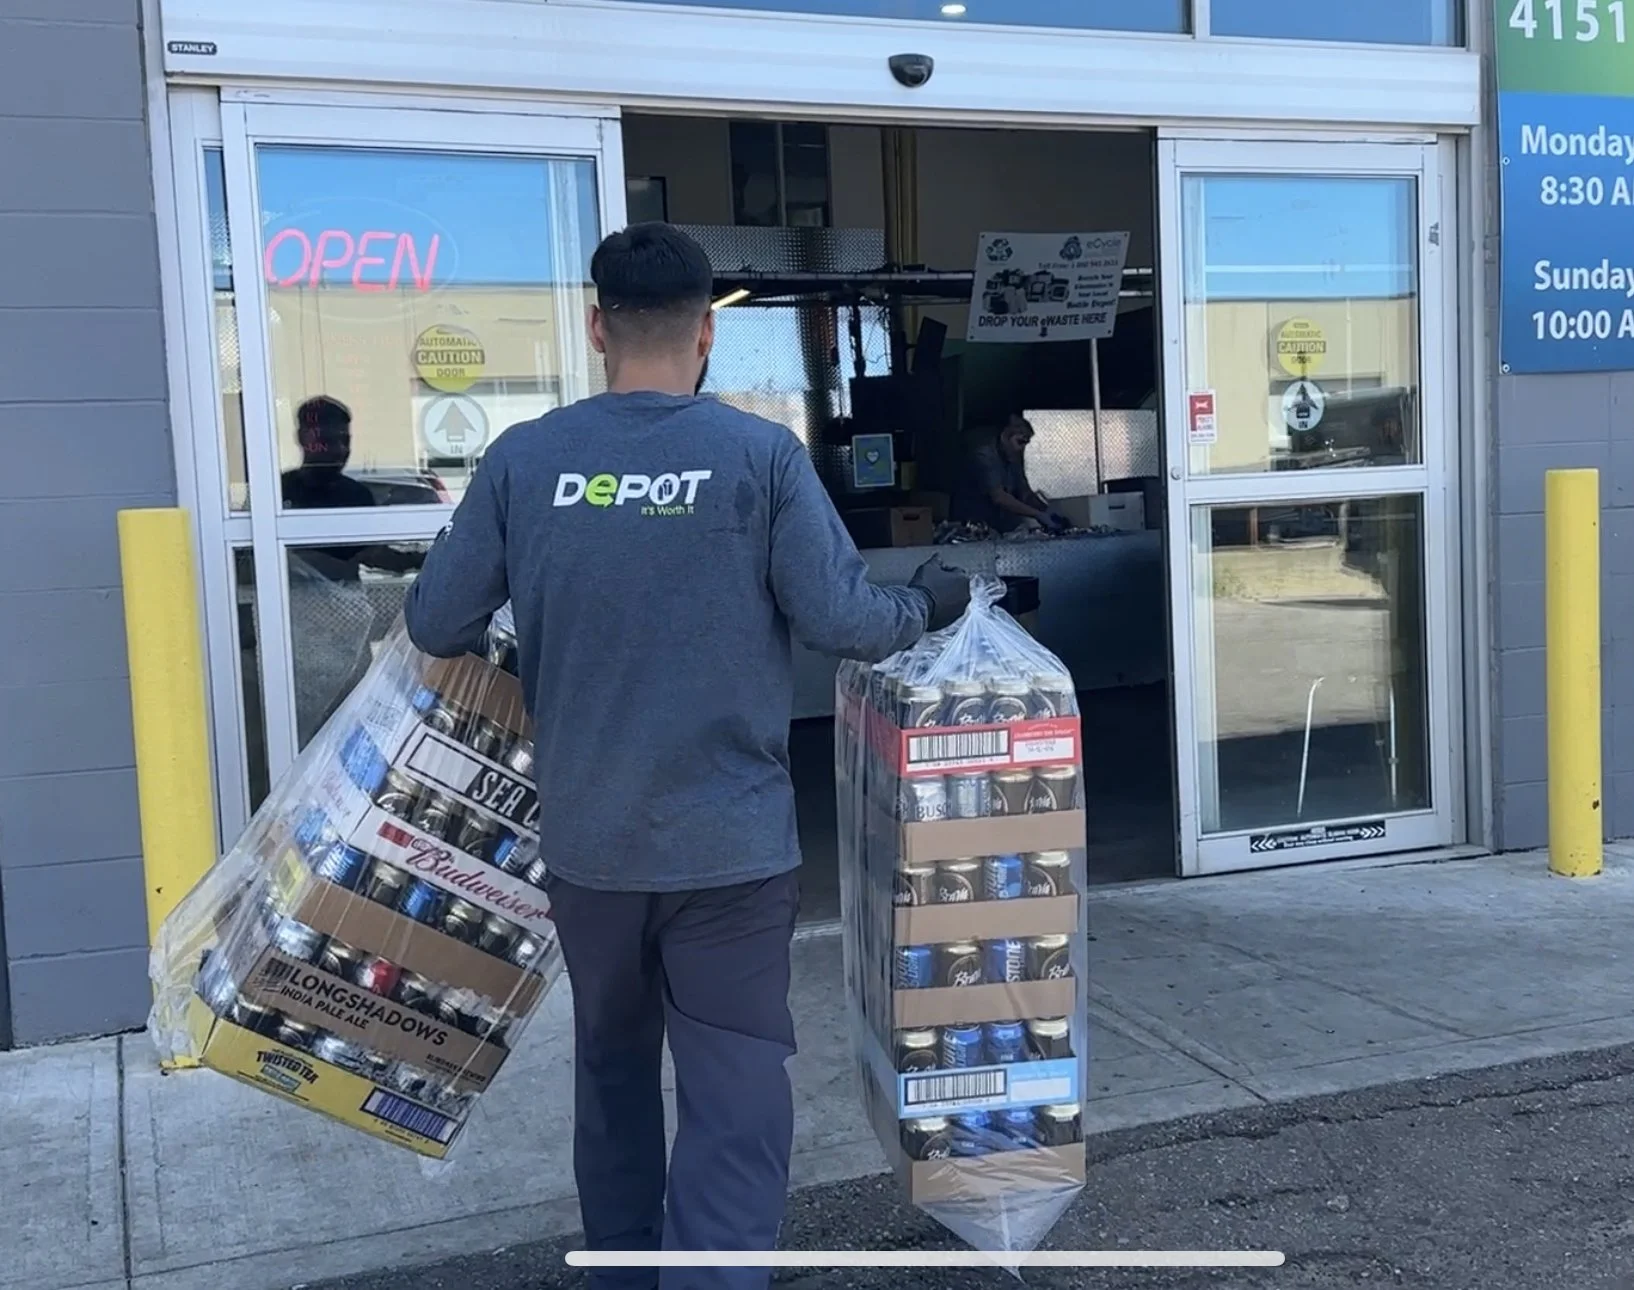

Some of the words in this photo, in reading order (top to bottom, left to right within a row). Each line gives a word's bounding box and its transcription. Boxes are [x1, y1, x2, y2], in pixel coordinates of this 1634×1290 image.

[171, 43, 214, 53] STANLEY
[1541, 176, 1604, 206] 8:30
[265, 228, 440, 293] OPEN
[978, 315, 1008, 327] DROP
[1010, 315, 1039, 327] YOUR
[1080, 312, 1107, 324] HERE
[1532, 309, 1612, 340] 10:00
[417, 350, 481, 363] CAUTION
[1278, 342, 1325, 353] CAUTION
[436, 367, 466, 378] DOOR
[450, 444, 463, 454] IN
[657, 506, 685, 516] Worth
[472, 771, 526, 818] SEA
[406, 838, 550, 920] Budweiser
[280, 985, 313, 1007] INDIA
[315, 1000, 343, 1020] PALE
[346, 1014, 370, 1030] ALE
[289, 967, 449, 1047] LONGSHADOWS
[256, 1050, 302, 1073] TWISTED
[298, 1065, 320, 1085] TEA
